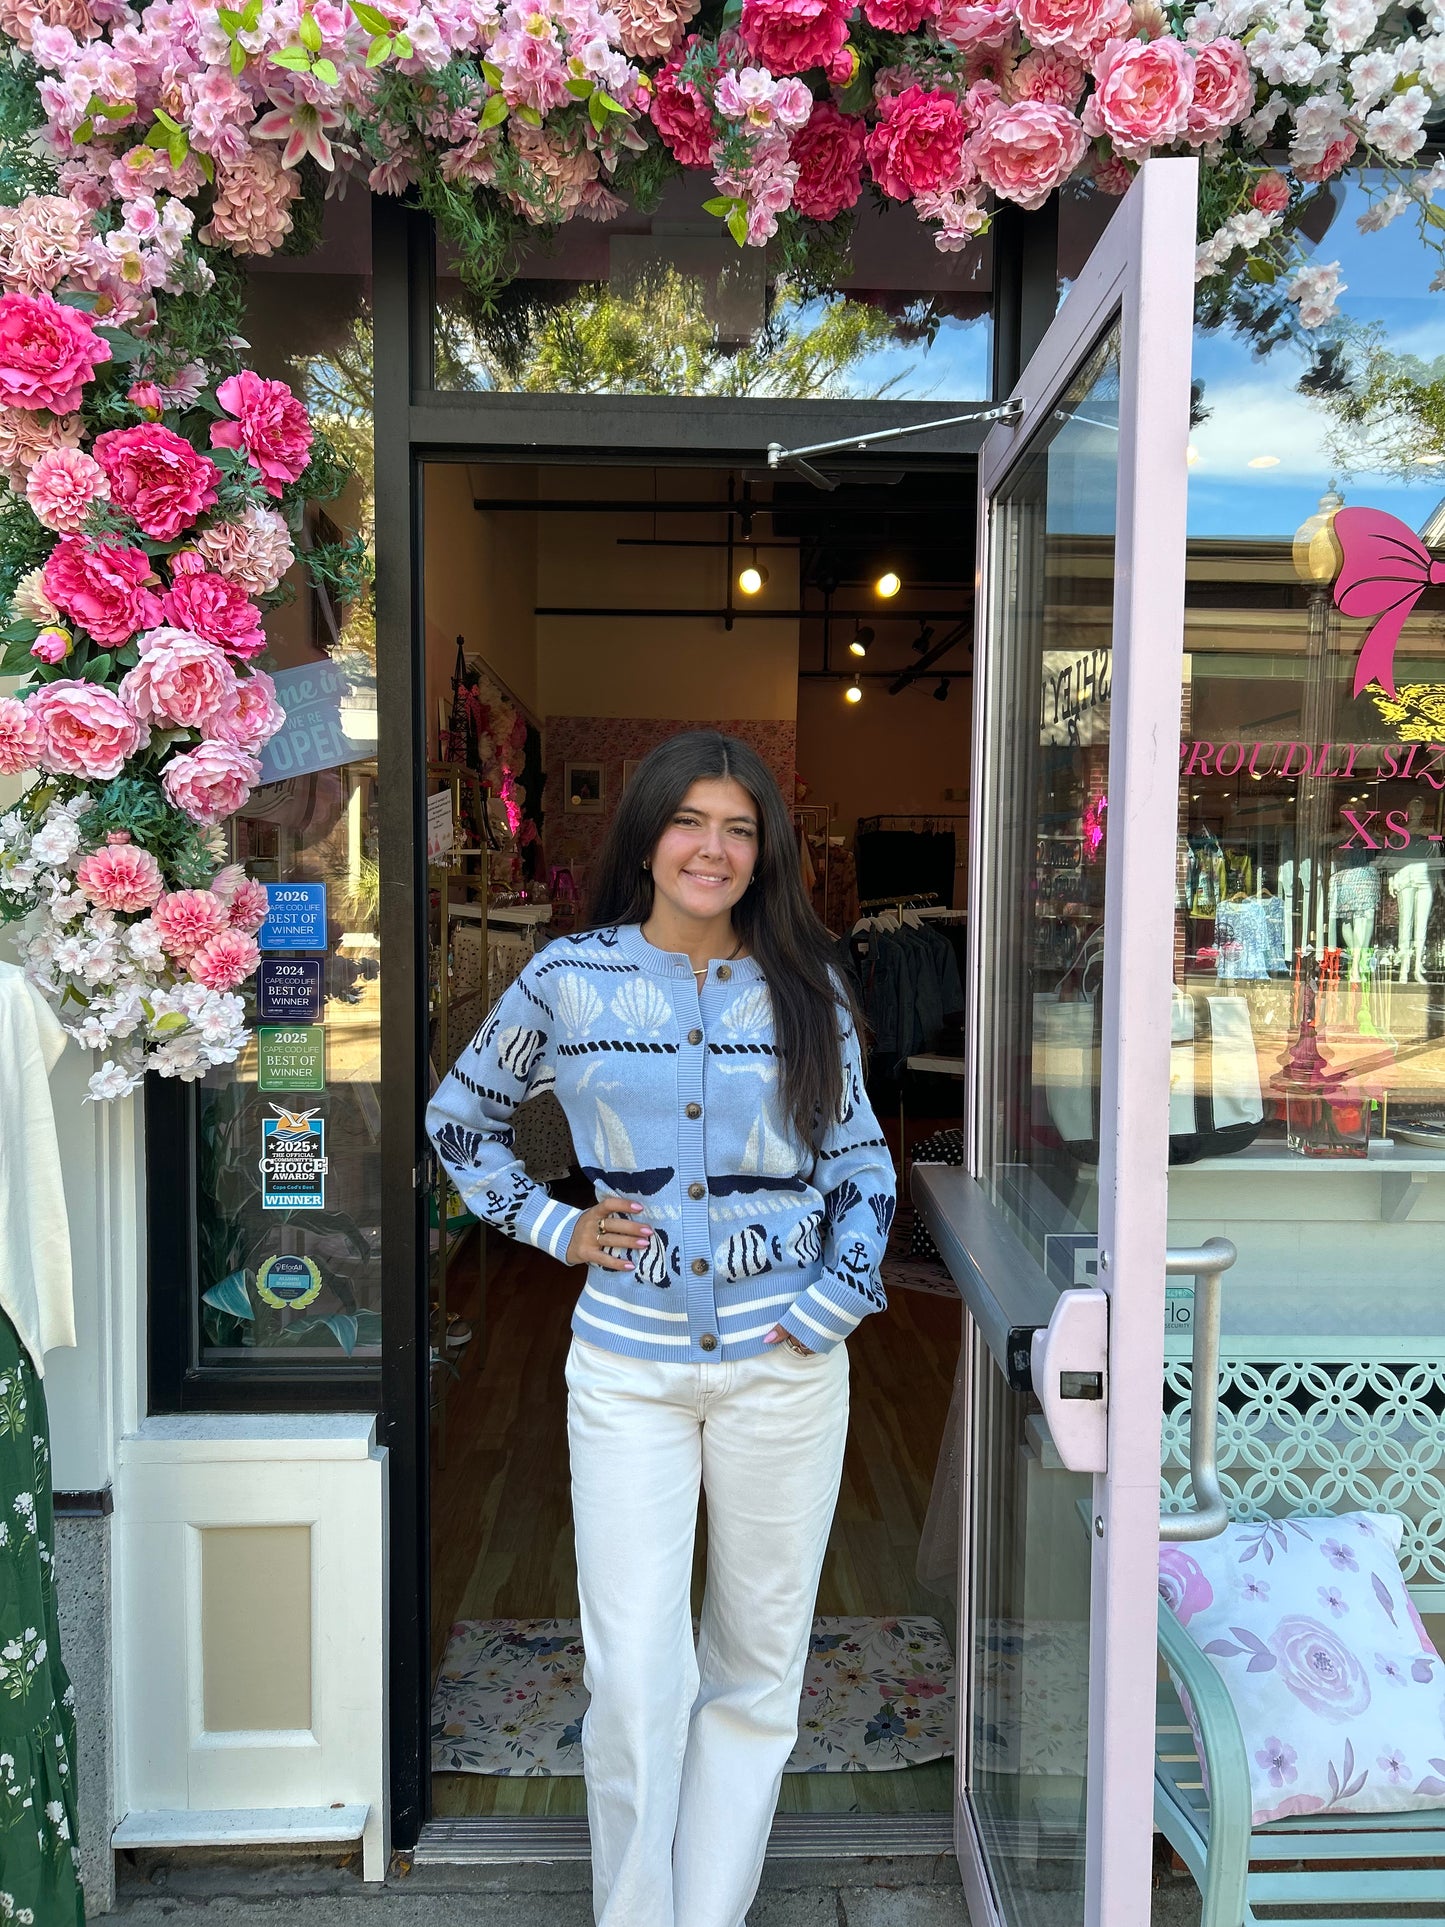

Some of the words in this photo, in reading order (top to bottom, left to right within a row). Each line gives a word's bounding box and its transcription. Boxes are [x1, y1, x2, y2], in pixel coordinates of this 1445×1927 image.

[285, 711, 323, 731] WE'RE
[268, 721, 359, 771] OPEN
[1376, 743, 1445, 790] SIZ
[1338, 810, 1411, 850] XS
[275, 891, 309, 902] 2026
[268, 914, 298, 924] BEST
[301, 914, 317, 924] OF
[271, 926, 314, 934] WINNER
[275, 966, 305, 976] 2024
[284, 977, 300, 985] COD
[268, 986, 295, 996] BEST
[297, 986, 313, 996] OF
[271, 998, 309, 1006] WINNER
[274, 1033, 308, 1044] 2025
[263, 1045, 284, 1053] CAPE
[284, 1045, 303, 1053] COD
[267, 1055, 297, 1066] BEST
[300, 1055, 317, 1066] OF
[270, 1068, 313, 1077] WINNER
[275, 1141, 311, 1152] 2025
[262, 1158, 326, 1173] CHOICE
[271, 1172, 315, 1180] AWARDS
[265, 1195, 321, 1205] WINNER
[1165, 1302, 1190, 1322] lo
